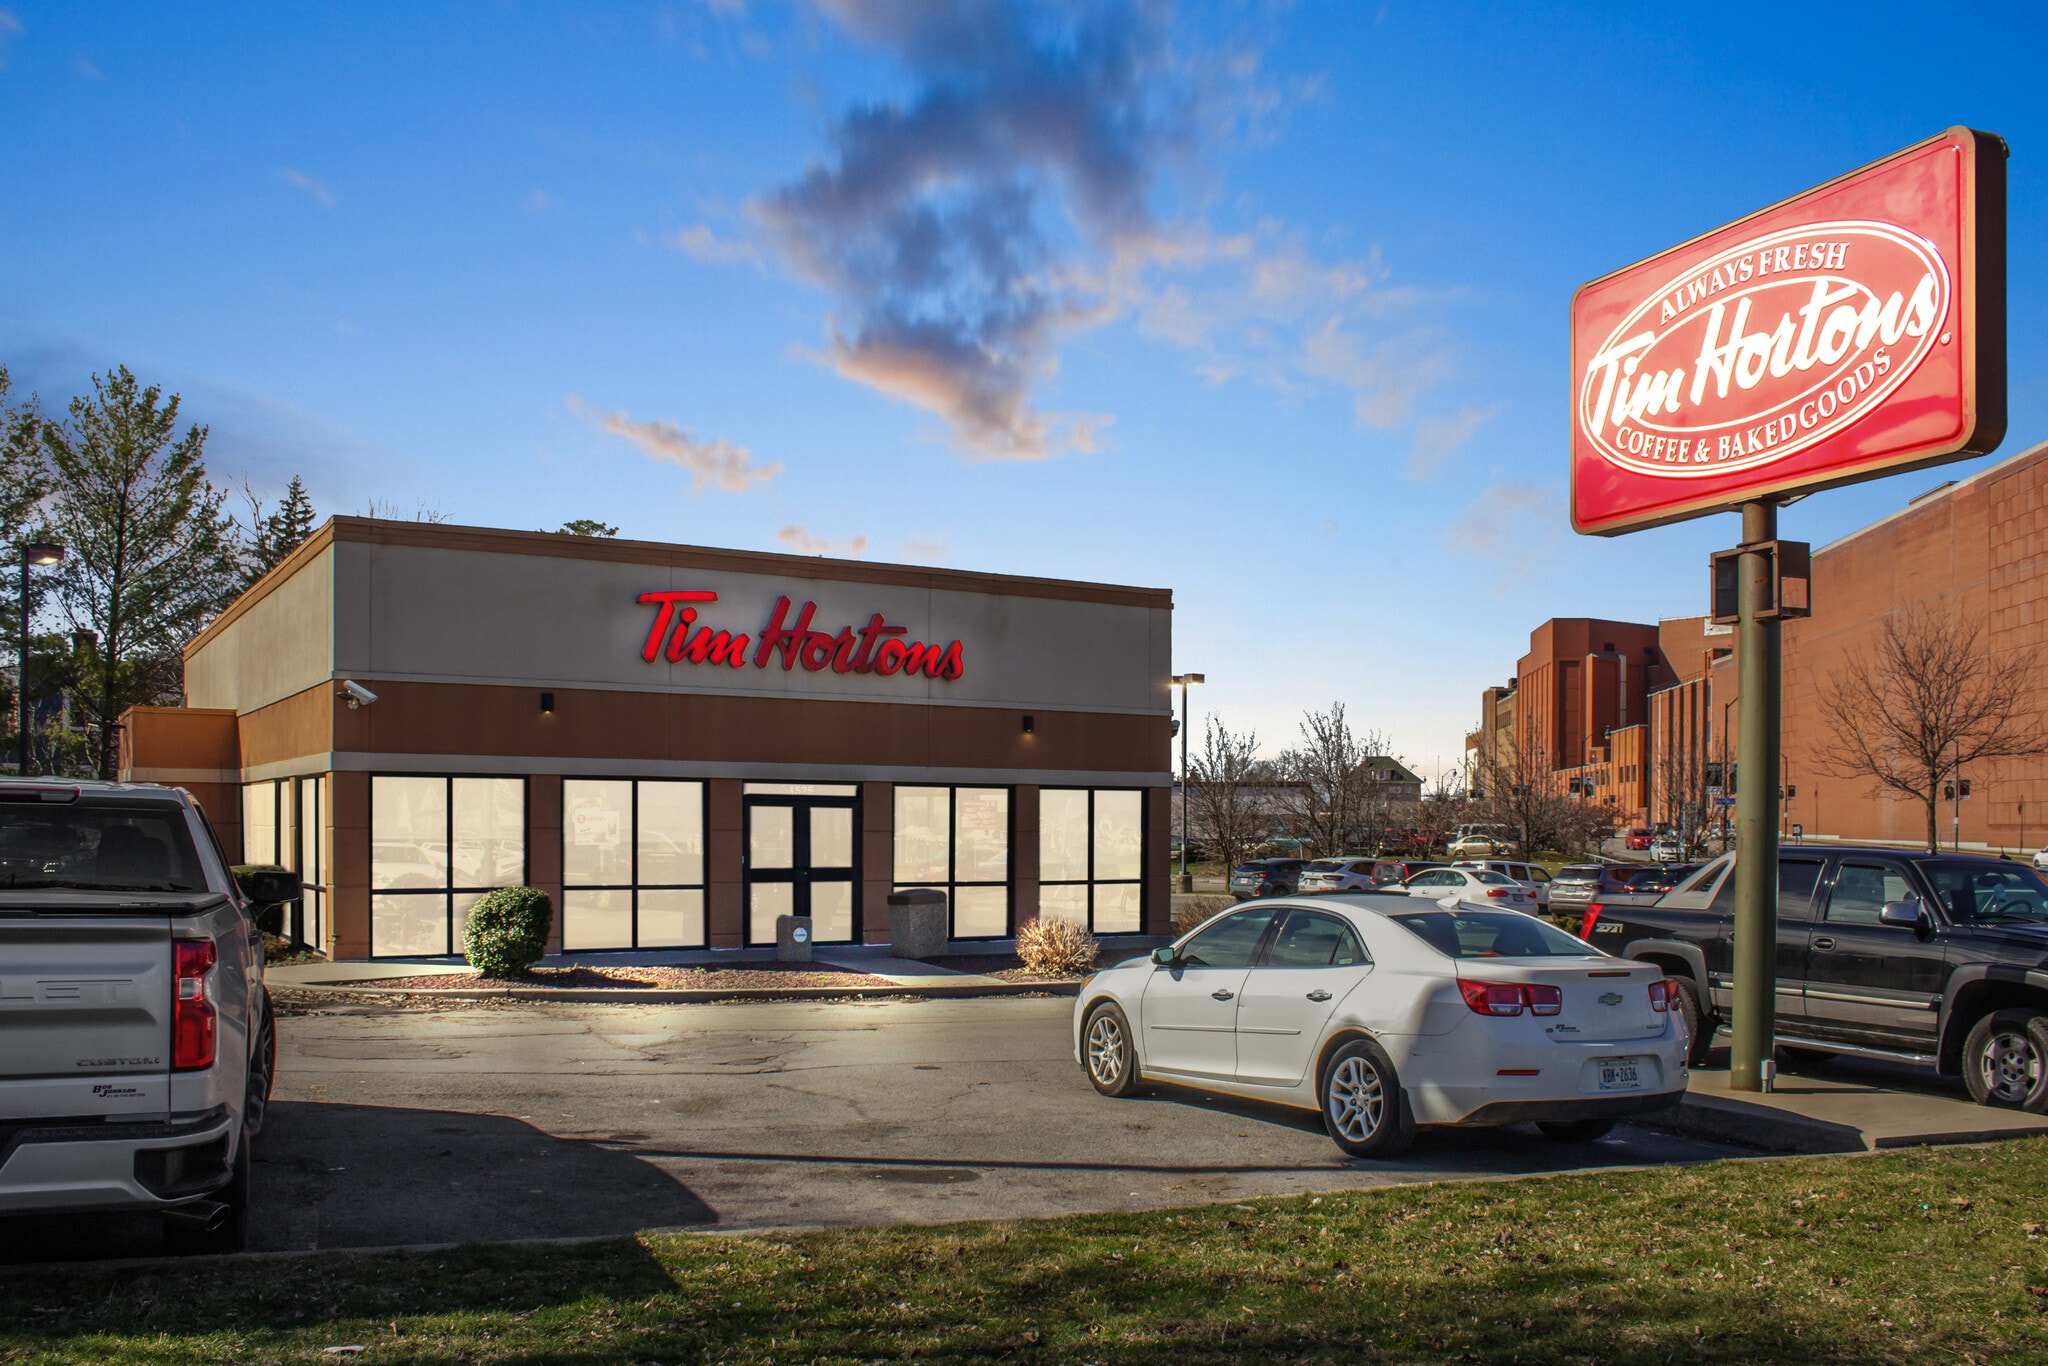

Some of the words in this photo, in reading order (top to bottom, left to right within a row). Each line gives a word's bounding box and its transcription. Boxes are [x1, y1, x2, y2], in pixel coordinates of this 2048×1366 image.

[1660, 255, 1753, 326] ALWAYS
[1758, 242, 1850, 277] FRESH
[1588, 331, 1686, 436] Tim
[1690, 273, 1937, 405] Hortons
[1616, 427, 1691, 463] COFFEE
[1694, 439, 1711, 463] &
[1718, 413, 1797, 461] BAKED
[1800, 347, 1892, 429] GOODS
[637, 590, 751, 669] Tim
[754, 594, 965, 680] Hortons
[76, 1057, 160, 1067] CUSTOM
